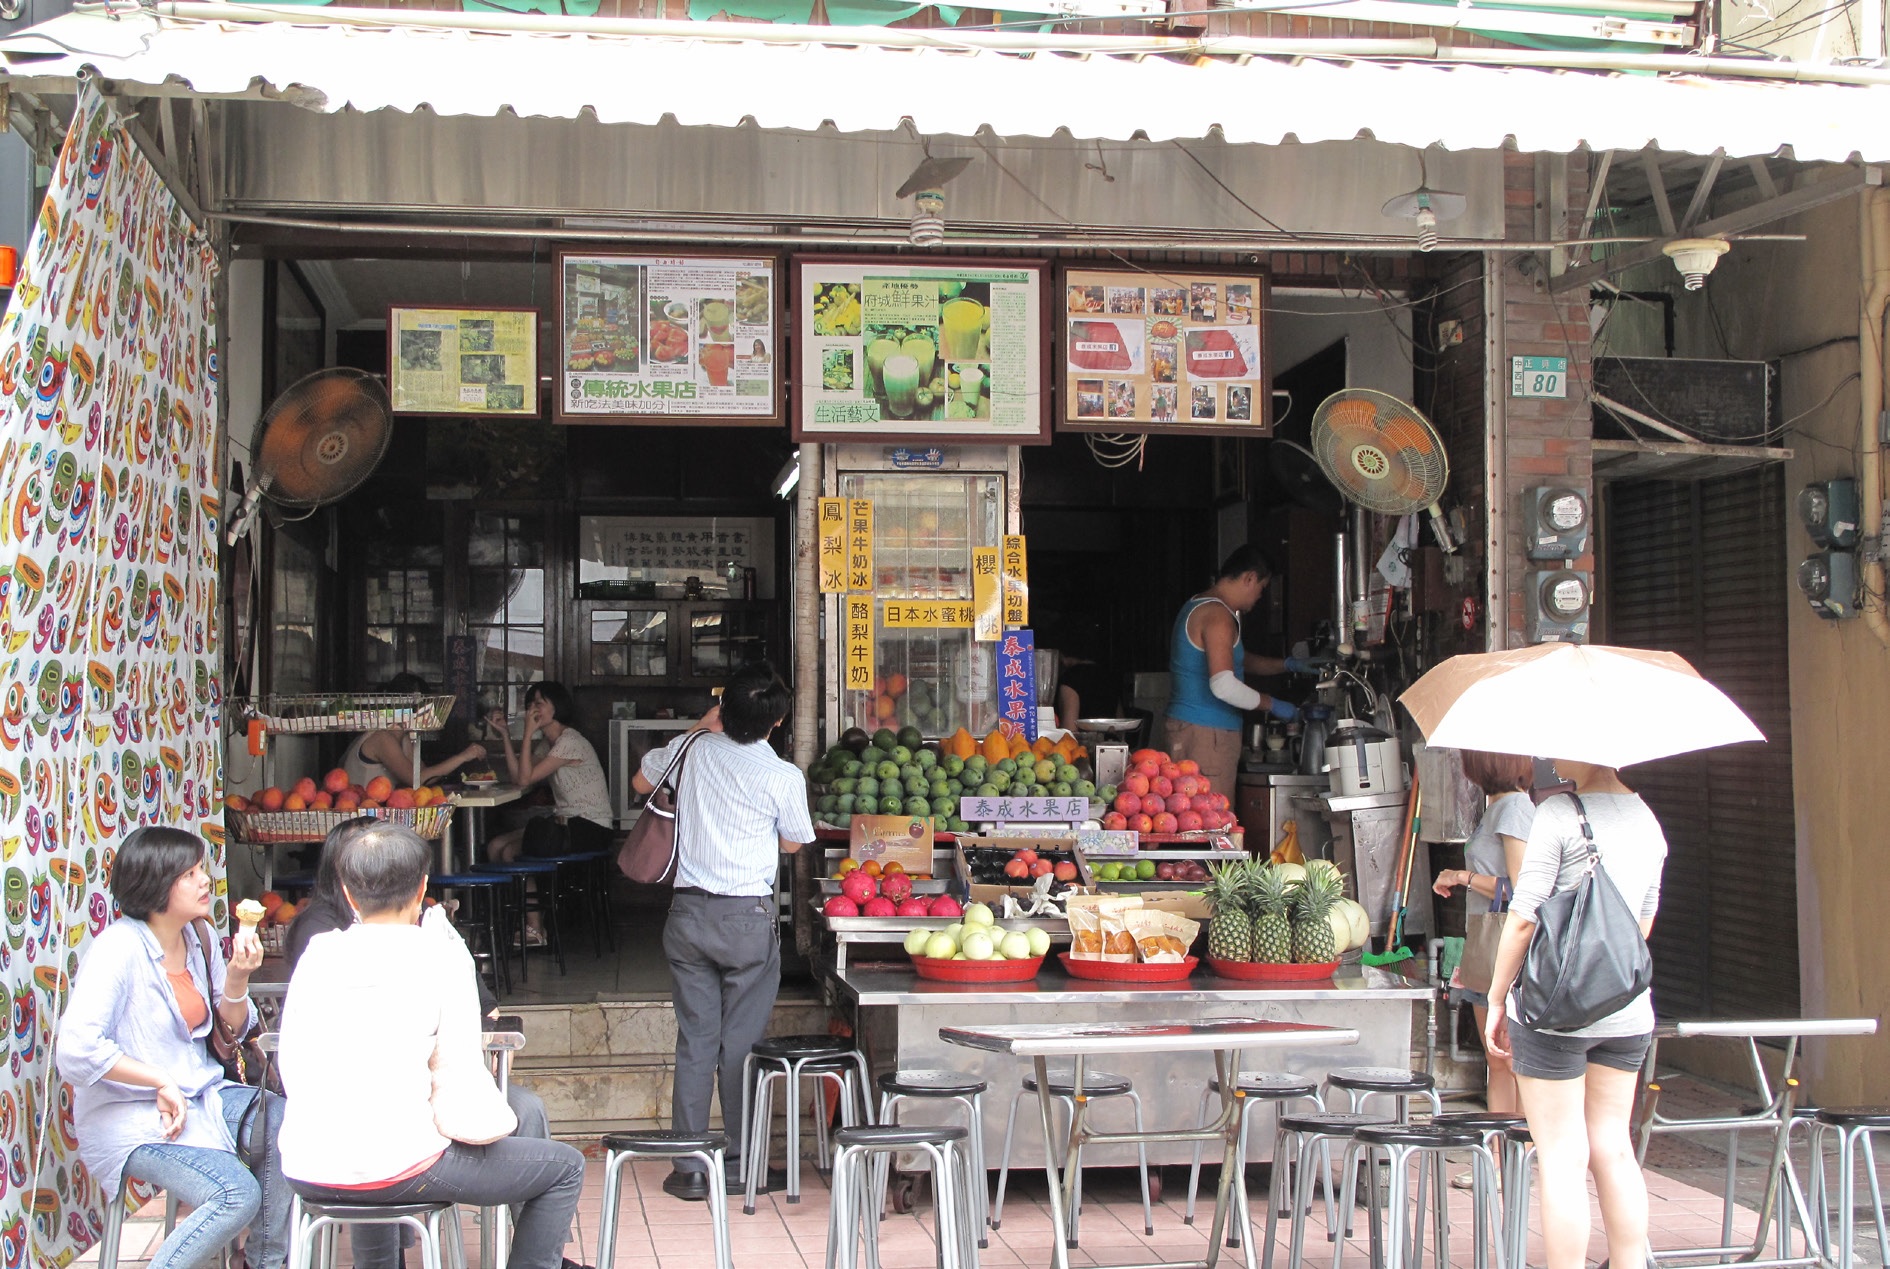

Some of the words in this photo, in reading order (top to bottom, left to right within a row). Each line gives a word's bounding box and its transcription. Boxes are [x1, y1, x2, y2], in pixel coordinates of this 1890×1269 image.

[864, 289, 938, 309] 府城鮮果汁
[1525, 359, 1566, 370] 正興街
[1514, 359, 1523, 393] 中西區
[1532, 374, 1557, 393] 80
[582, 379, 697, 399] 傳統水果店
[570, 399, 666, 410] 新吃法美味加分
[815, 405, 879, 423] 生活藝文
[823, 502, 843, 589] 鳳梨冰
[853, 501, 868, 586] 芒果牛奶冰
[1006, 537, 1022, 622] 綜合水果切盤
[976, 555, 998, 635] 櫻桃
[888, 606, 975, 622] 日本水蜜桃
[851, 602, 868, 683] 酪梨牛奶
[975, 799, 1082, 818] 泰成水果店
